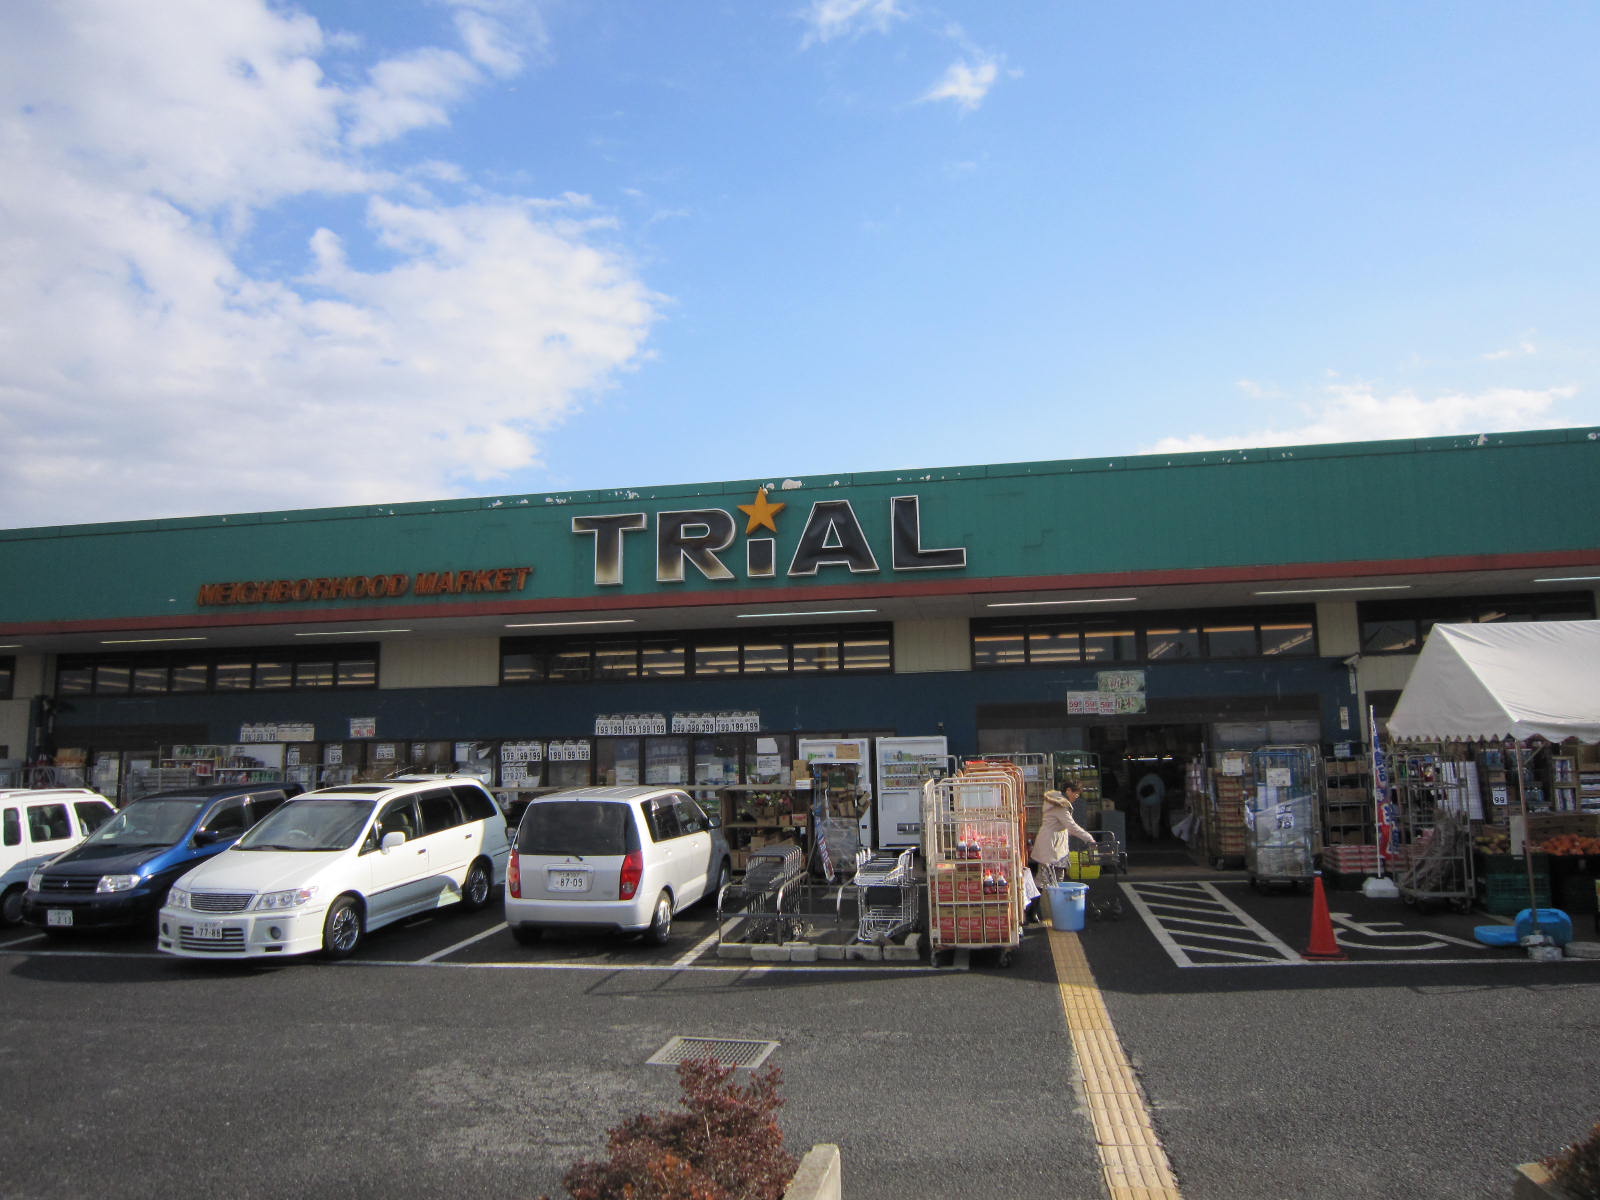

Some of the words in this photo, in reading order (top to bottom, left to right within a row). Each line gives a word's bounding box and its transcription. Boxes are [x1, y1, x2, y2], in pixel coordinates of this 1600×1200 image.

[198, 574, 409, 607] NEIGHBORHOOD
[414, 567, 533, 596] MARKET
[597, 725, 609, 734] 199
[625, 725, 637, 734] 199
[653, 725, 665, 734] 199
[701, 724, 714, 732] 399
[731, 723, 744, 731] 199
[746, 722, 758, 731] 199
[564, 751, 576, 760] 199
